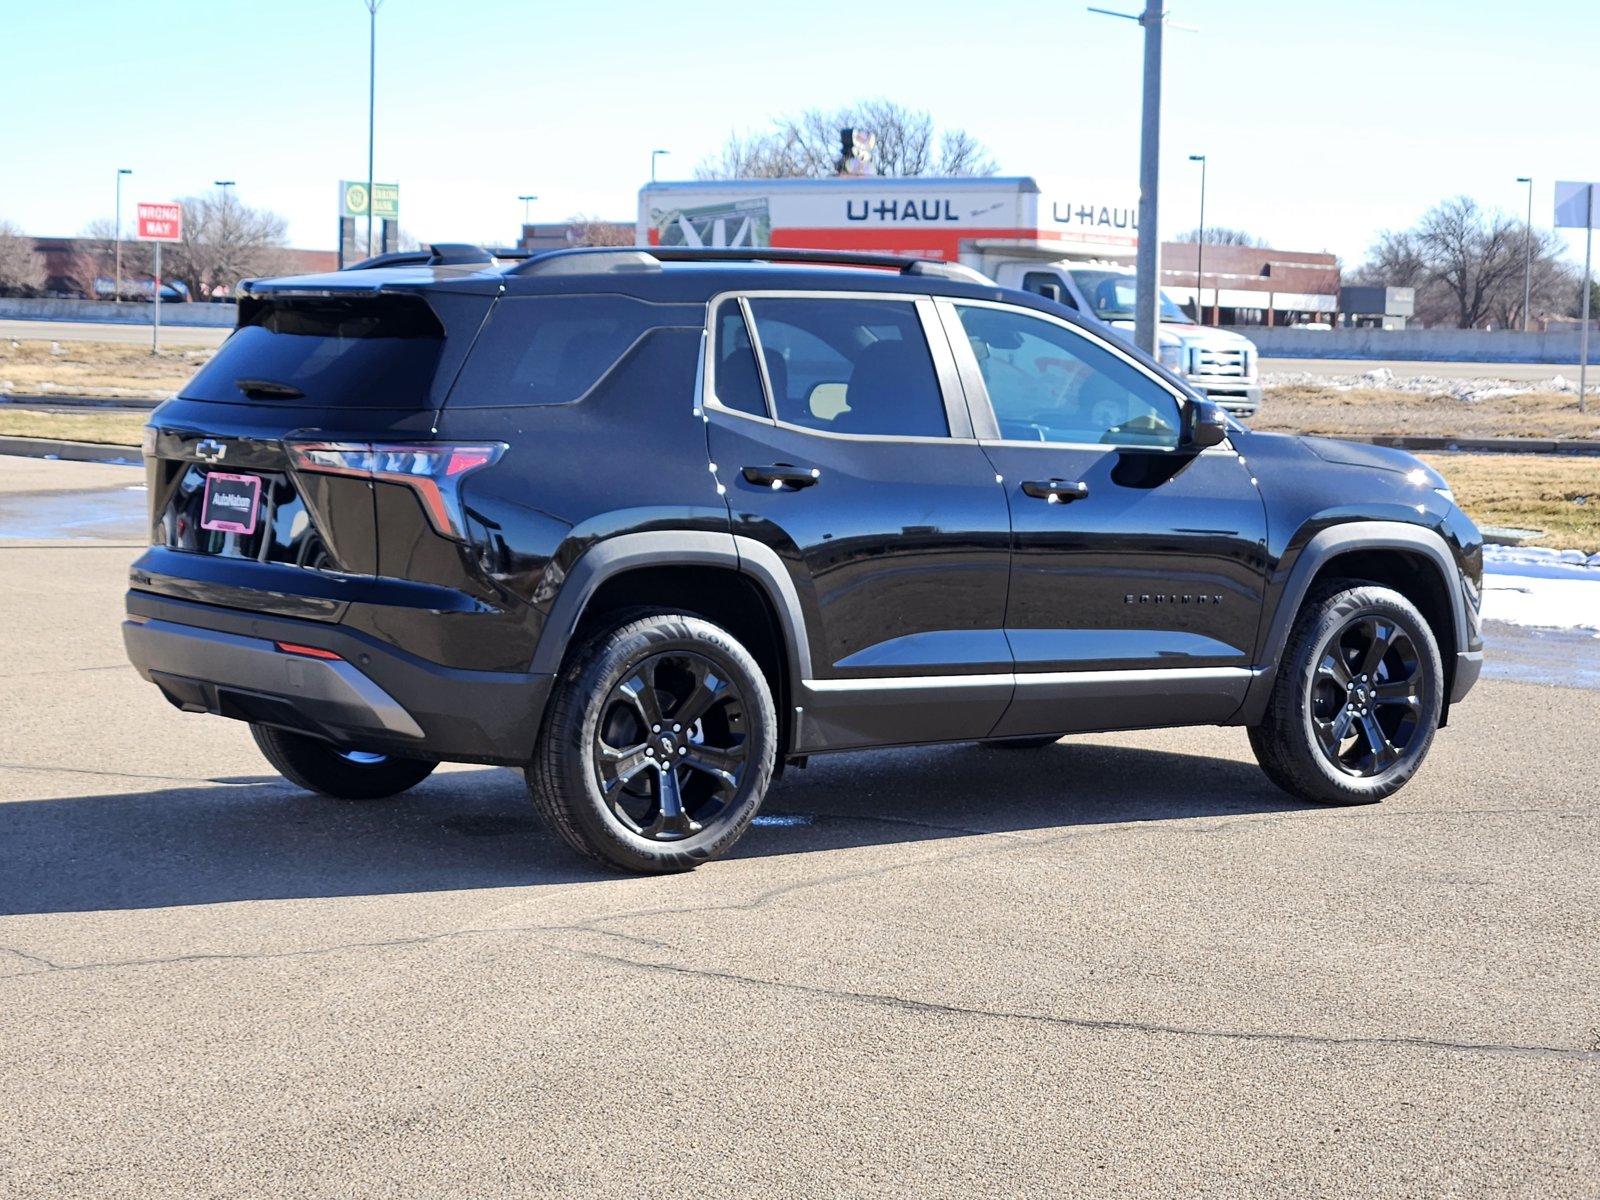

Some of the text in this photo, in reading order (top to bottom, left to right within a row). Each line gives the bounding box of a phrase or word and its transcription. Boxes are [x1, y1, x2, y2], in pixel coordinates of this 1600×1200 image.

[138, 205, 178, 221] WRONG
[146, 220, 171, 235] WAY
[1124, 593, 1224, 605] EQUINOX
